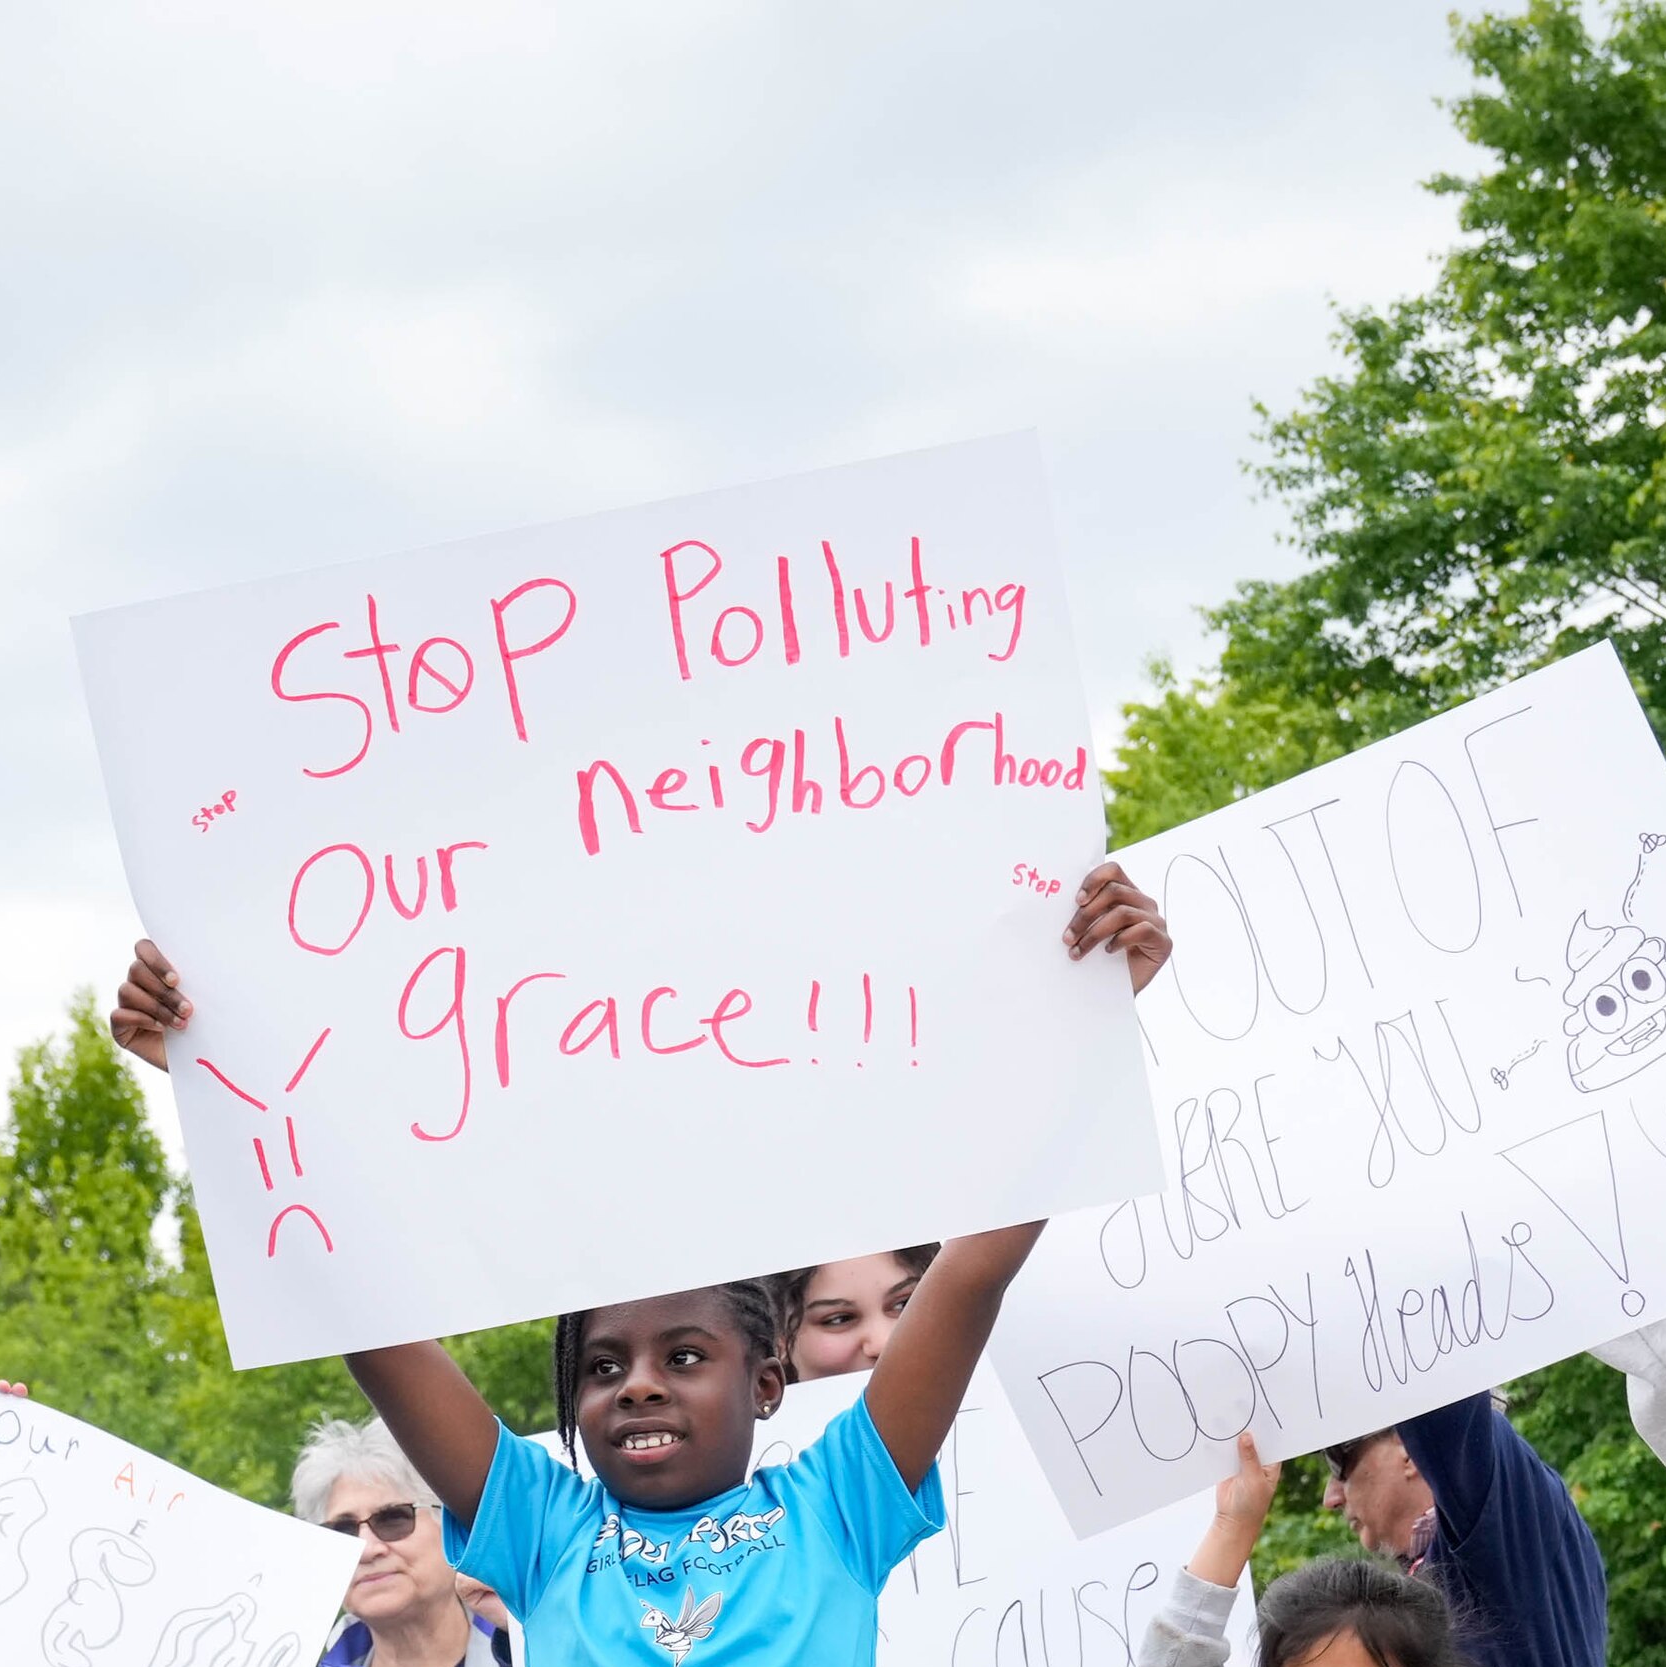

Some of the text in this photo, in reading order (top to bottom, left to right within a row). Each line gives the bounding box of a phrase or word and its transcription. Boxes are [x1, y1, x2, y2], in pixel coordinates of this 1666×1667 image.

[576, 712, 1088, 857] neighborhood
[286, 840, 490, 956] Our
[1163, 705, 1540, 1042] OUT OF
[1037, 1272, 1324, 1497] POOPY
[113, 1460, 186, 1513] Air
